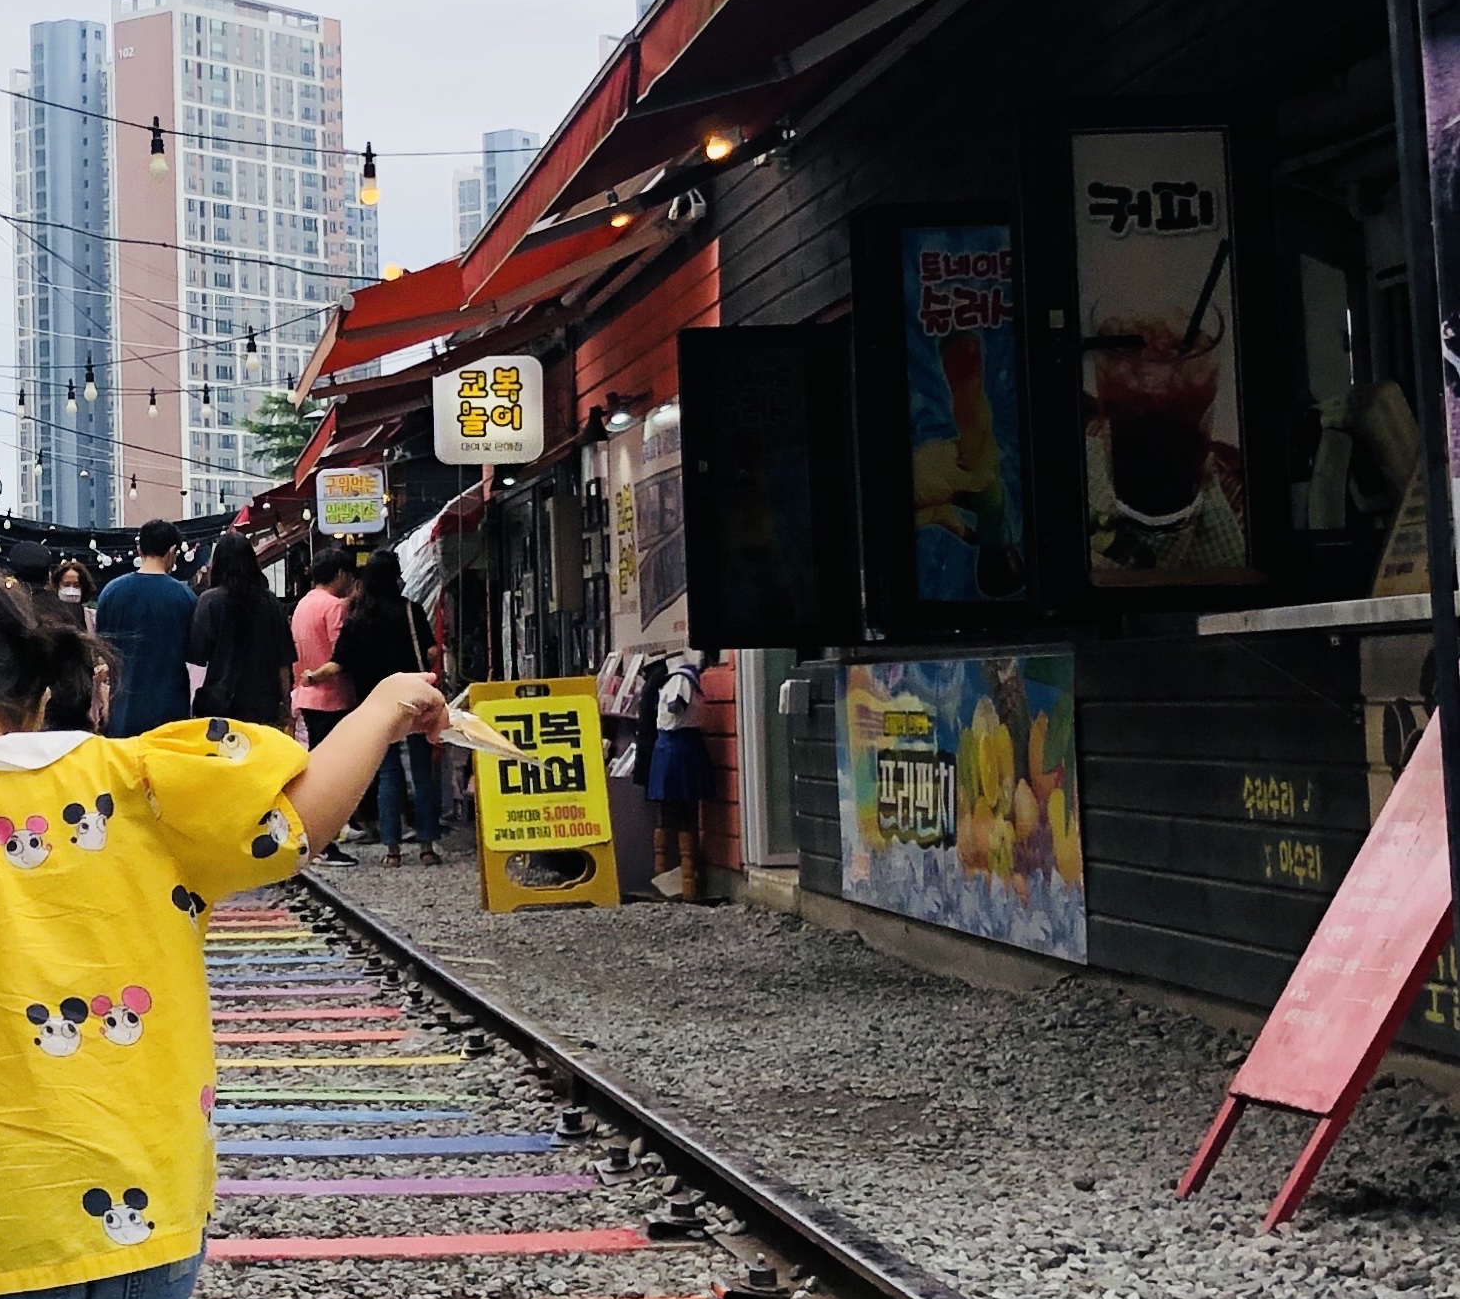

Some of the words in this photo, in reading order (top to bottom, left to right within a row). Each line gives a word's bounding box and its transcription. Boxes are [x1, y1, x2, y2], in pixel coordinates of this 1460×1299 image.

[1088, 181, 1213, 233] 커피
[458, 366, 523, 403] 교복
[457, 400, 523, 437] 놀이
[325, 475, 376, 496] 구워먹는
[325, 502, 378, 523] 임실치즈
[495, 710, 581, 750] 교복
[498, 753, 587, 795] 대여
[1242, 774, 1295, 820] 수리수리
